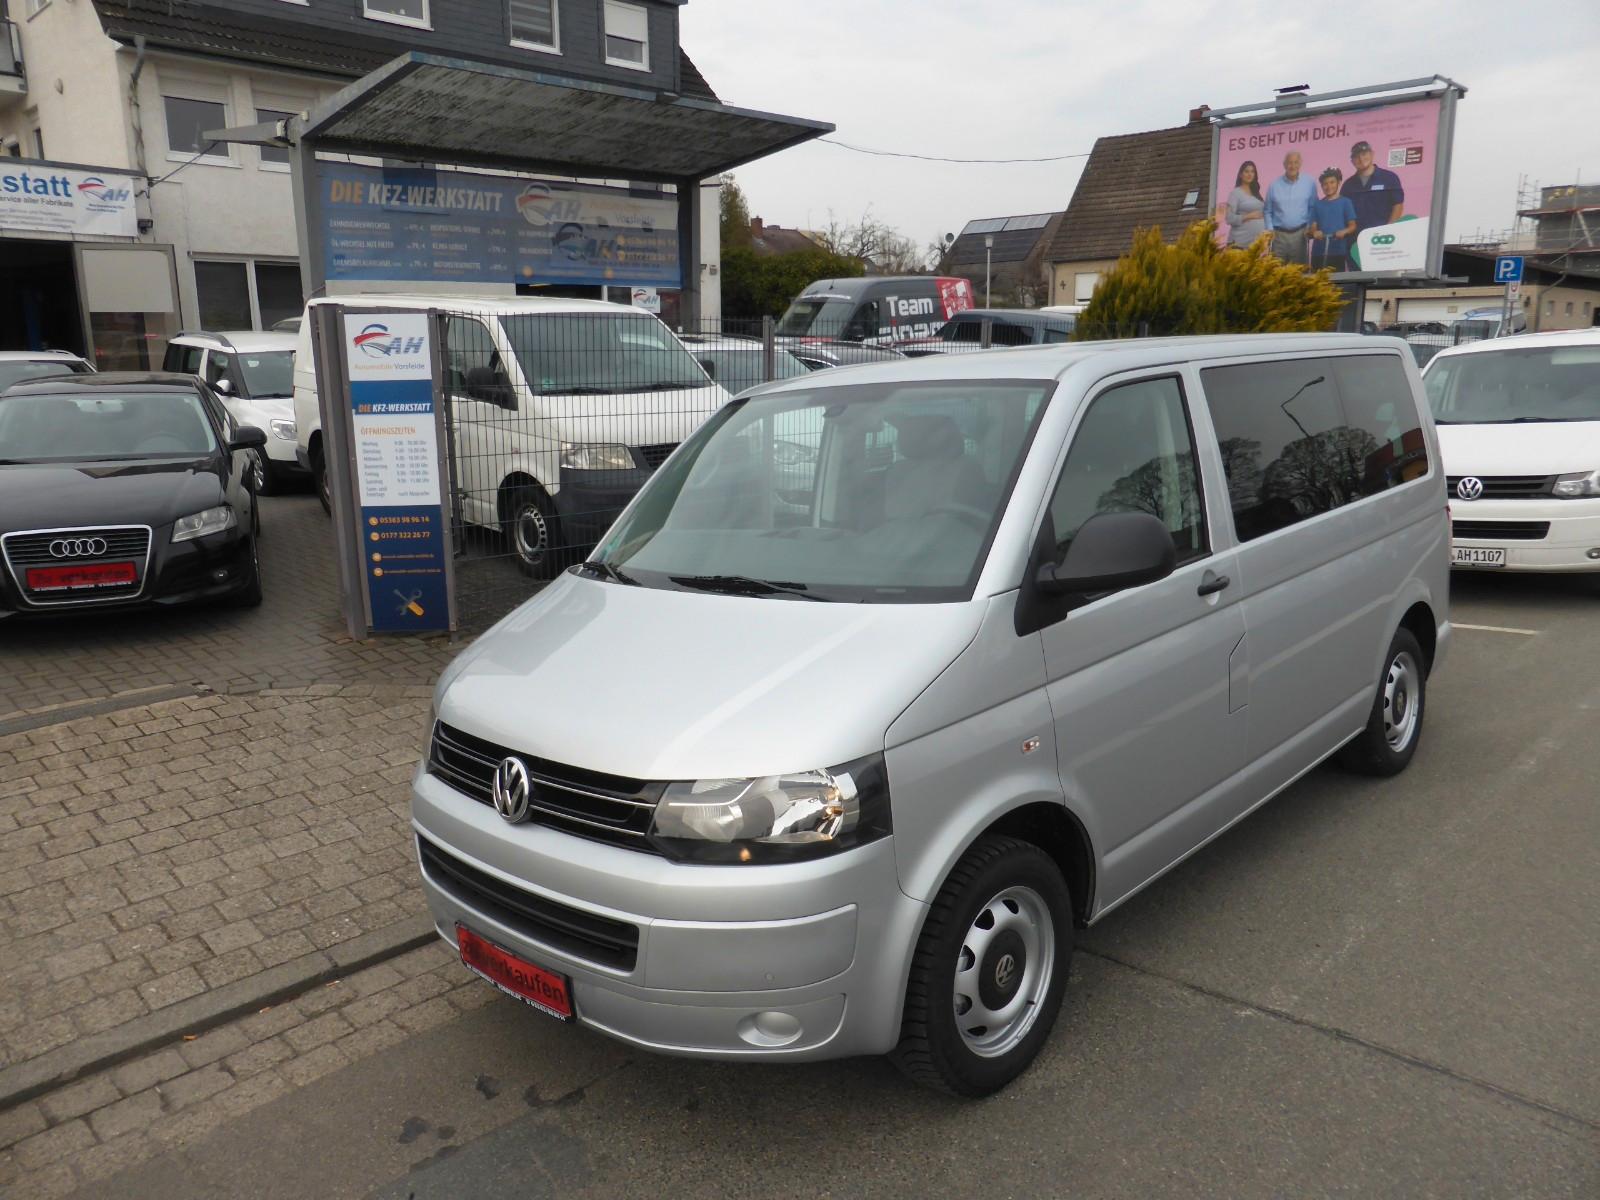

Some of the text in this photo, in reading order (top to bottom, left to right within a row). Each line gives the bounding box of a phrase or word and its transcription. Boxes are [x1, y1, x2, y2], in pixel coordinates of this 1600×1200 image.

[1229, 138, 1246, 151] ES
[1250, 132, 1284, 149] GEHT
[1288, 128, 1309, 143] UM
[1312, 124, 1350, 141] DICH.
[0, 172, 72, 197] statt
[331, 180, 502, 212] DIE KFZ-WERKSTATT
[1500, 260, 1514, 279] P
[885, 296, 934, 317] Team
[386, 337, 424, 355] AH
[372, 403, 431, 413] KFZ-WERKSTATT
[1456, 549, 1503, 562] AH 1107
